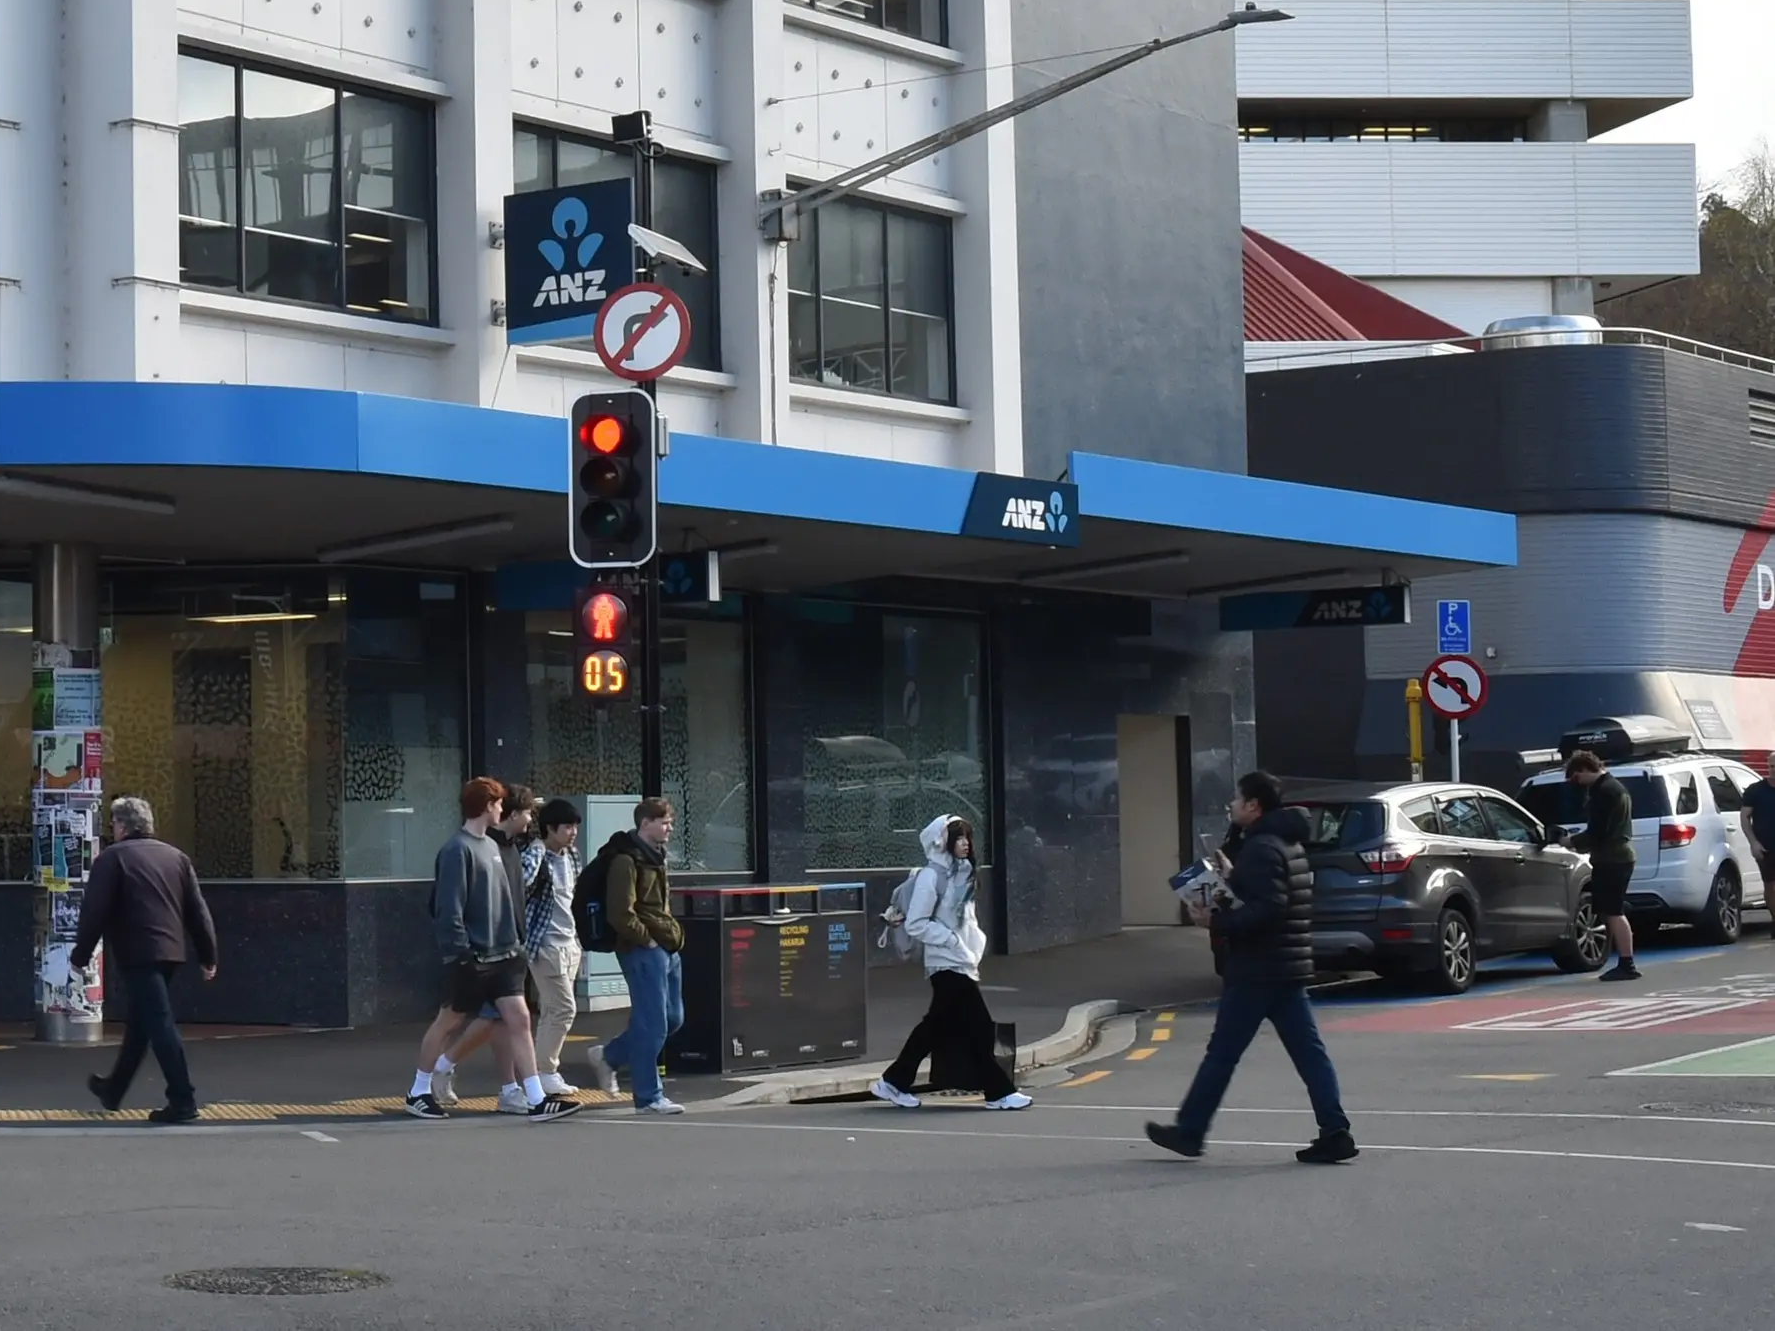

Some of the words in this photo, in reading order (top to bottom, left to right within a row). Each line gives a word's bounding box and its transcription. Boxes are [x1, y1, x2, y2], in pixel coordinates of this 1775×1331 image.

[533, 269, 606, 307] ANZ
[1002, 497, 1045, 531] ANZ
[1312, 599, 1363, 620] ANZ
[1448, 602, 1458, 615] P
[584, 655, 624, 691] 05
[779, 925, 809, 936] RECYCLING
